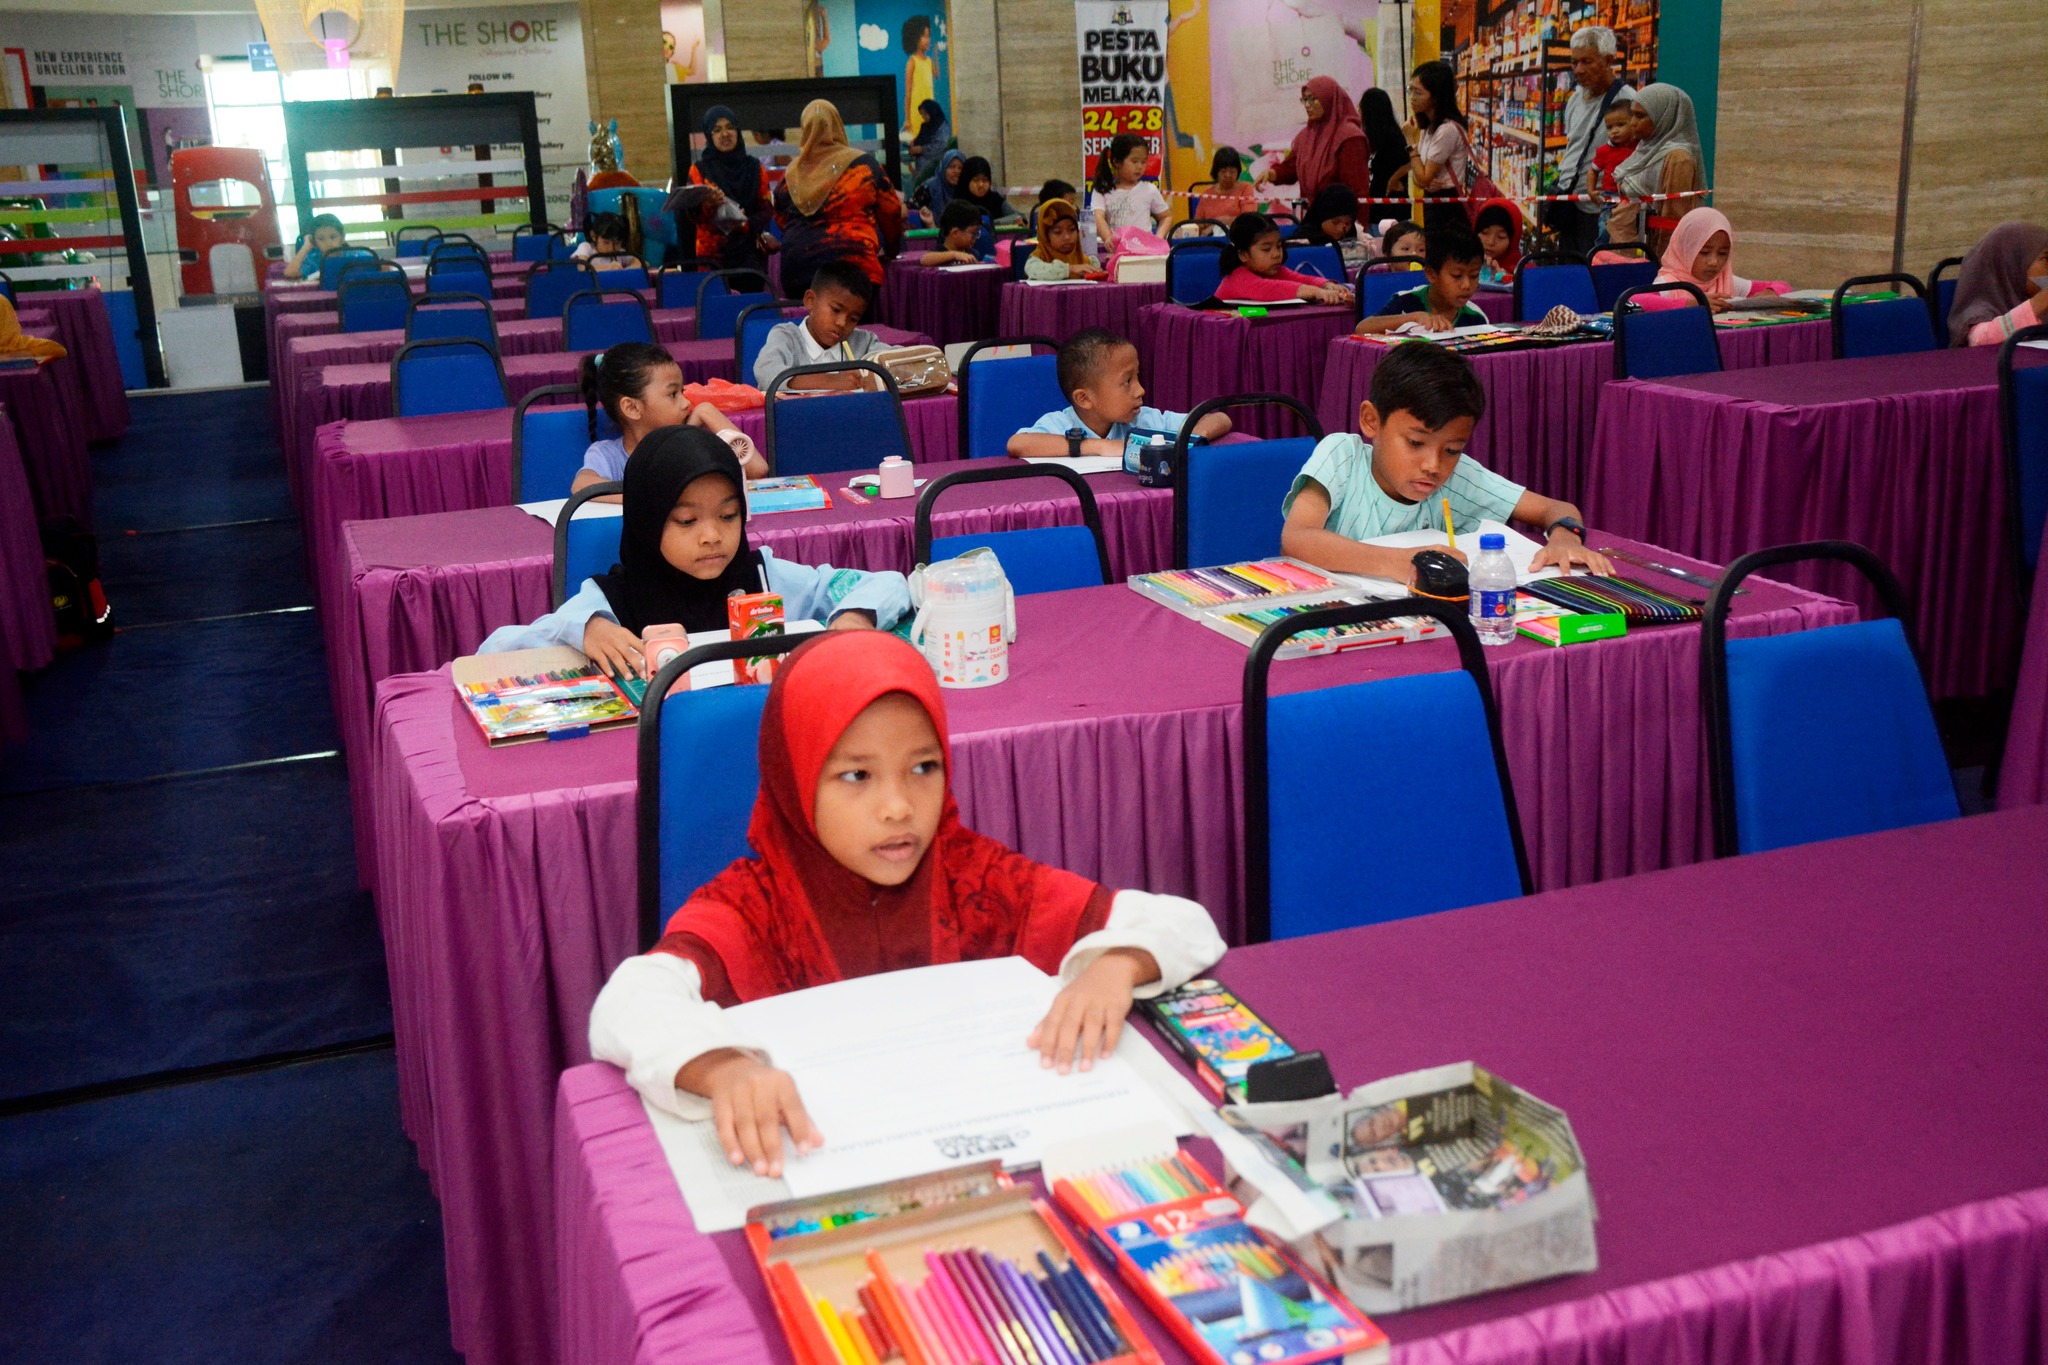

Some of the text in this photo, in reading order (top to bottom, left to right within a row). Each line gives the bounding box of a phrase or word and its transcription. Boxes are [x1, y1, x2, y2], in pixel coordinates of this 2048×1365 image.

[419, 20, 558, 46] THE SHORE
[1085, 30, 1160, 51] PESTA
[35, 52, 123, 63] NEW EXPERIENCE
[36, 64, 126, 76] UNVEILING SOON
[156, 70, 187, 84] THE
[1081, 55, 1164, 82] BUKU
[159, 85, 204, 99] SHOR
[1083, 87, 1161, 104] MELAKA
[1084, 137, 1160, 155] SEPER
[750, 607, 774, 615] drinho
[1153, 1209, 1196, 1233] 12
